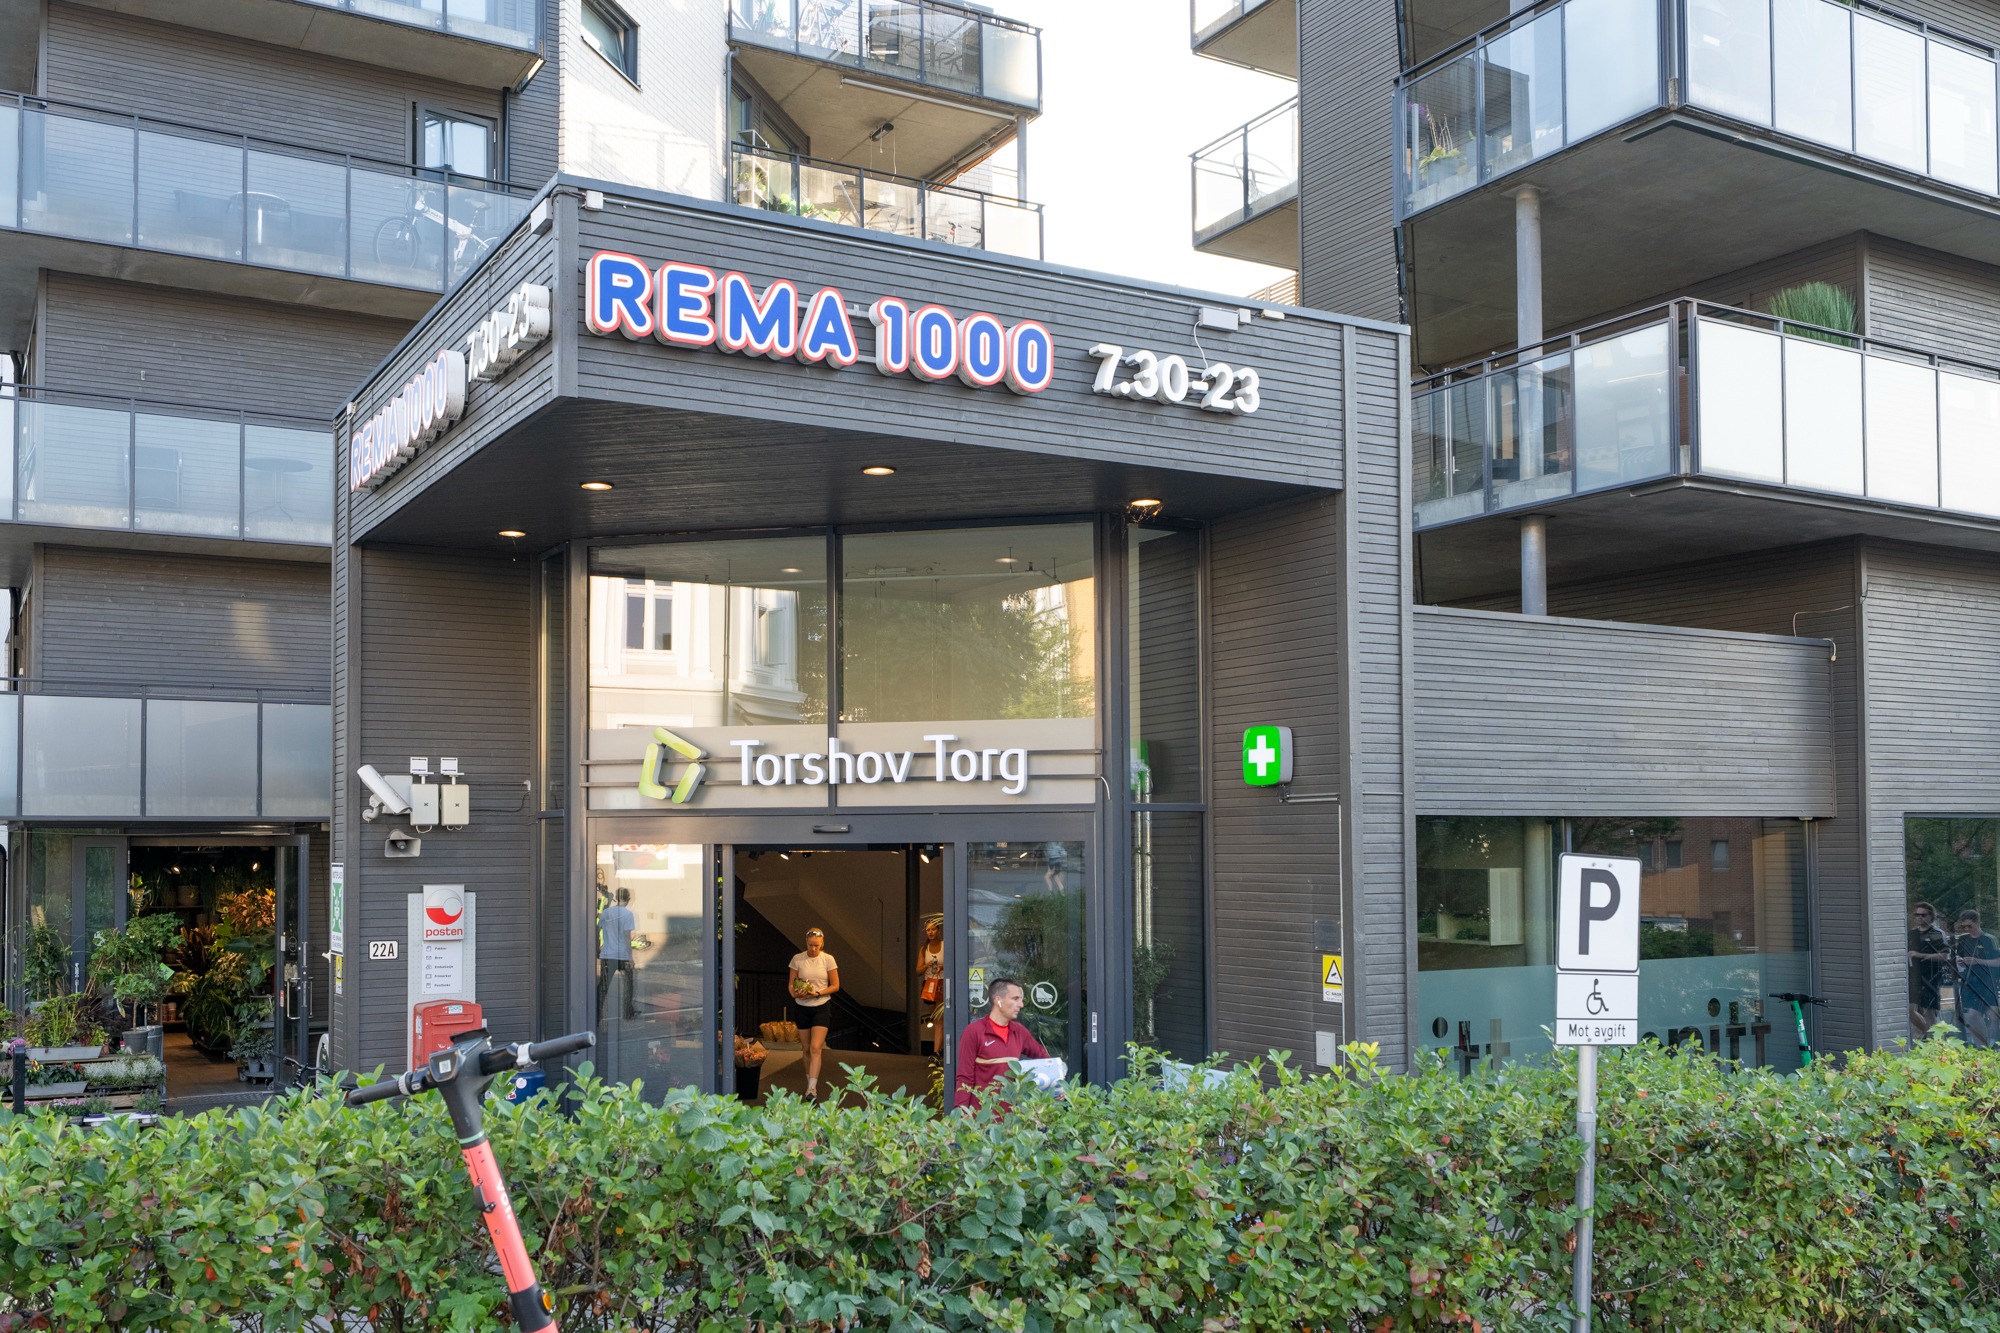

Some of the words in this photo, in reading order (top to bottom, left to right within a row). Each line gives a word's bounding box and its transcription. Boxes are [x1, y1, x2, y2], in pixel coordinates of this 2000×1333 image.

[466, 282, 531, 382] 7.30-23
[586, 250, 857, 369] REMA
[870, 297, 1055, 394] 1000
[1089, 342, 1260, 415] 7.30-23
[350, 396, 399, 492] REMA
[402, 349, 448, 445] 1000
[730, 737, 914, 787] Torshov
[924, 733, 1029, 795] Torg
[425, 927, 463, 938] posten
[1578, 867, 1621, 955] P
[373, 943, 394, 957] 22A
[1568, 1023, 1590, 1038] Mot
[1594, 1023, 1627, 1041] avgift
